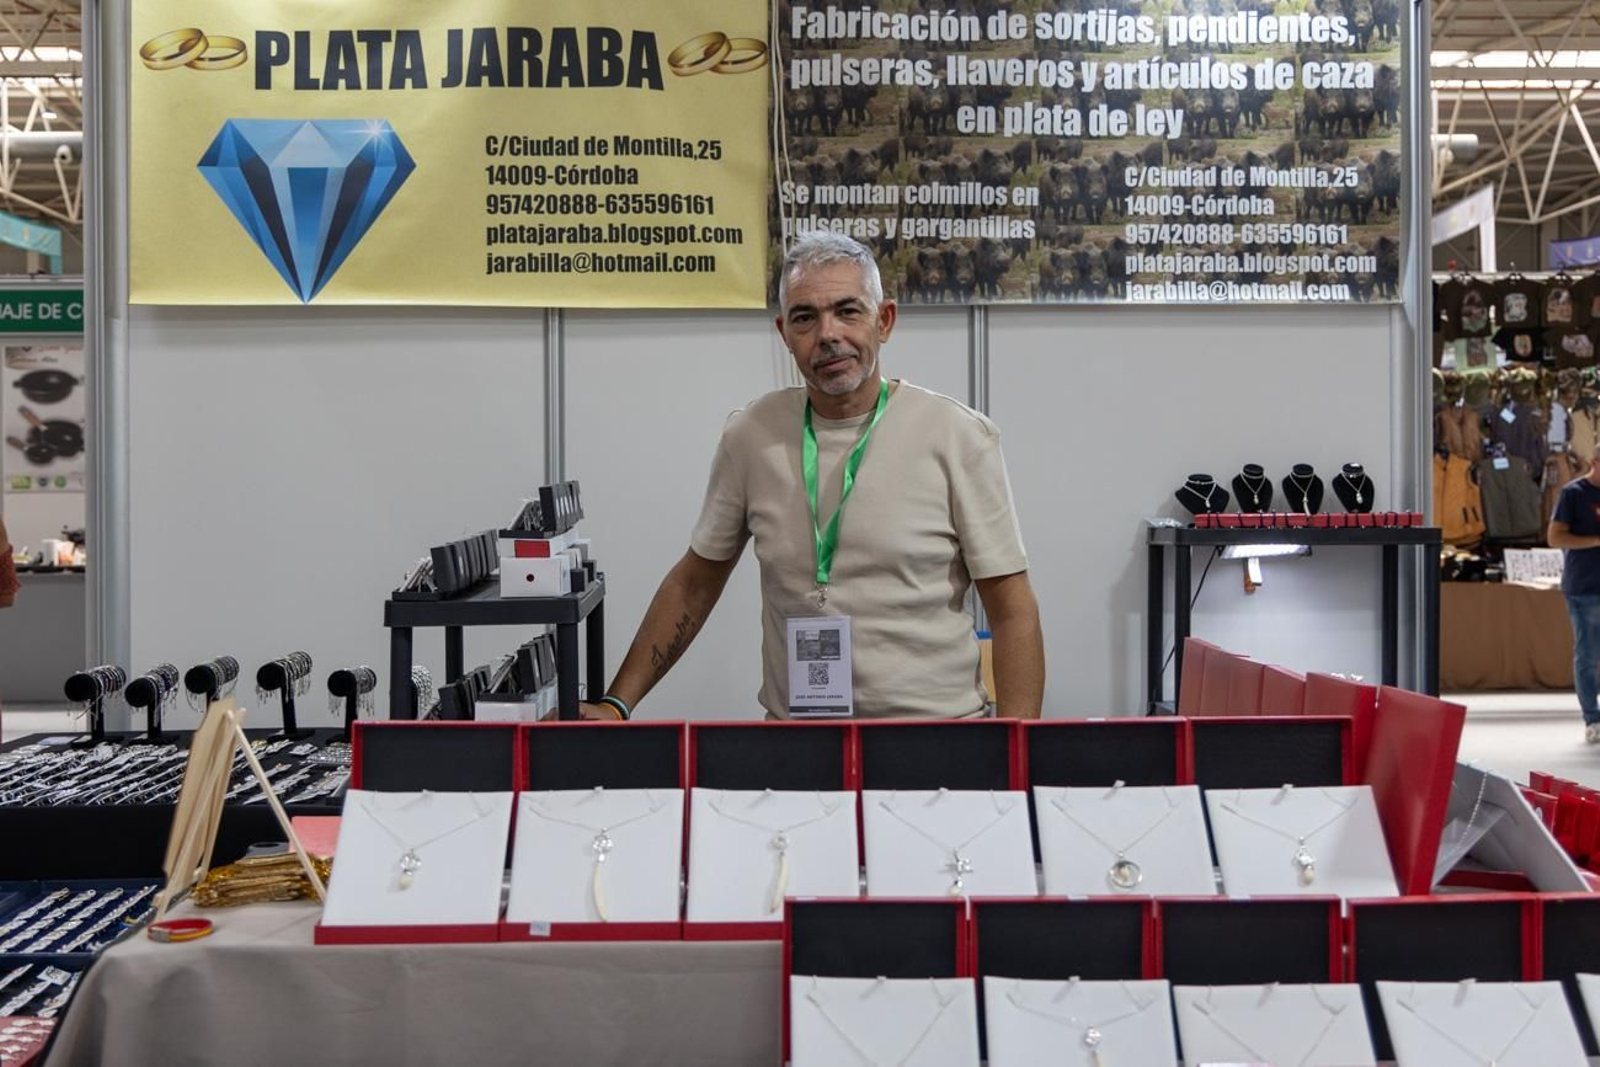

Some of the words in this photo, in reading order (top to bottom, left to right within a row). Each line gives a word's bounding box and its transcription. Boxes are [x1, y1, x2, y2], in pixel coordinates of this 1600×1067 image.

[791, 5, 981, 42] Fabricación
[987, 10, 1028, 41] de
[1034, 9, 1162, 46] sortijas,
[1168, 10, 1356, 47] pendientes,
[254, 29, 428, 91] PLATA
[441, 26, 665, 91] JARABA
[790, 53, 941, 90] pulseras,
[946, 54, 1075, 89] llaveros
[1080, 62, 1098, 93] y
[1103, 57, 1248, 91] artículos
[1254, 58, 1295, 91] de
[1301, 61, 1375, 90] caza
[957, 104, 996, 134] en
[1003, 101, 1083, 138] plata
[1089, 104, 1128, 137] de
[1136, 104, 1184, 140] ley
[485, 135, 580, 157] C/Ciudad
[583, 136, 609, 156] de
[613, 135, 722, 161] Montilla,25
[485, 164, 640, 186] 14009-Córdoba
[1124, 166, 1217, 188] C/Ciudad
[1220, 167, 1246, 188] de
[486, 193, 715, 216] 957420888-635596161
[781, 180, 811, 204] Se
[813, 182, 899, 205] montan
[903, 181, 1007, 206] colmillos
[1012, 185, 1039, 206] en
[1124, 194, 1275, 216] 14009-Córdoba
[486, 223, 744, 246] platajaraba.blogspot.com
[884, 217, 897, 239] y
[901, 215, 1036, 240] gargantillas
[1124, 223, 1349, 246] 957420888-635596161
[486, 252, 716, 275] jarabilla@hotmail.com
[1124, 252, 1378, 275] platajaraba.blogspot.com
[1124, 281, 1350, 301] jarabilla@hotmail.com
[0, 303, 32, 319] AJE
[39, 303, 61, 319] DE
[67, 303, 84, 319] C
